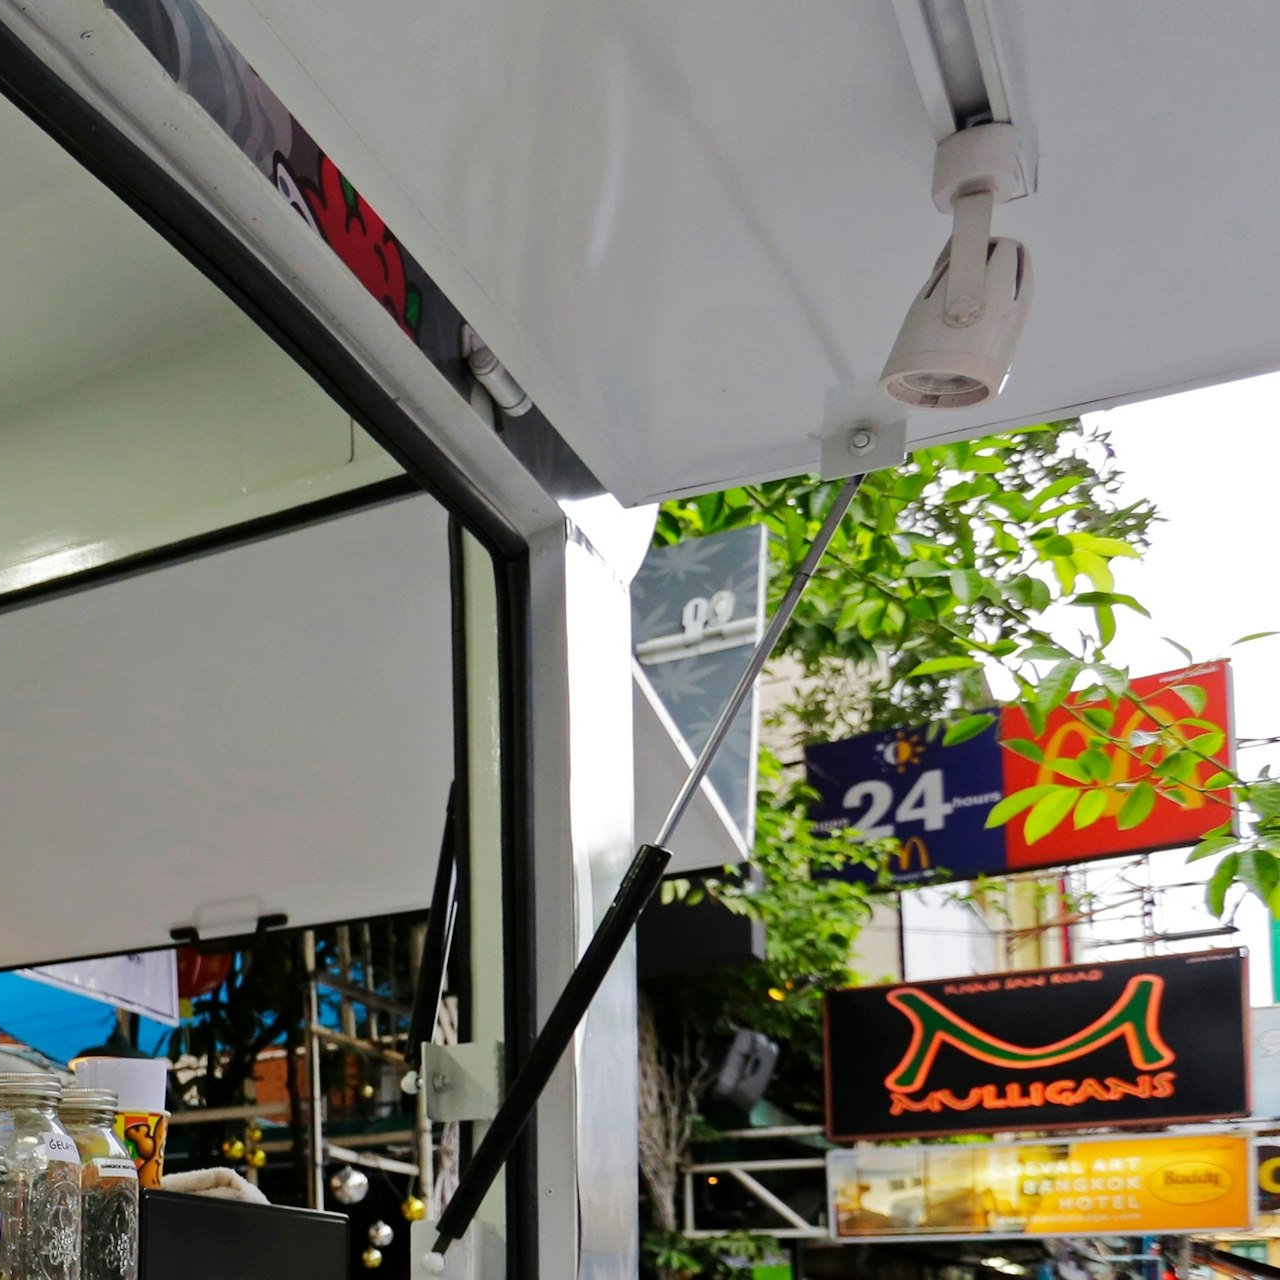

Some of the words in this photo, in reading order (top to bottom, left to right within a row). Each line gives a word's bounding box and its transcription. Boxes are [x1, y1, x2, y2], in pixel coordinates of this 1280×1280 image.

[842, 769, 953, 844] 24
[890, 1071, 1177, 1116] MULLIGANS
[1092, 1157, 1142, 1173] ART
[1022, 1176, 1142, 1195] BANGKOK
[1058, 1195, 1143, 1210] HOTEL
